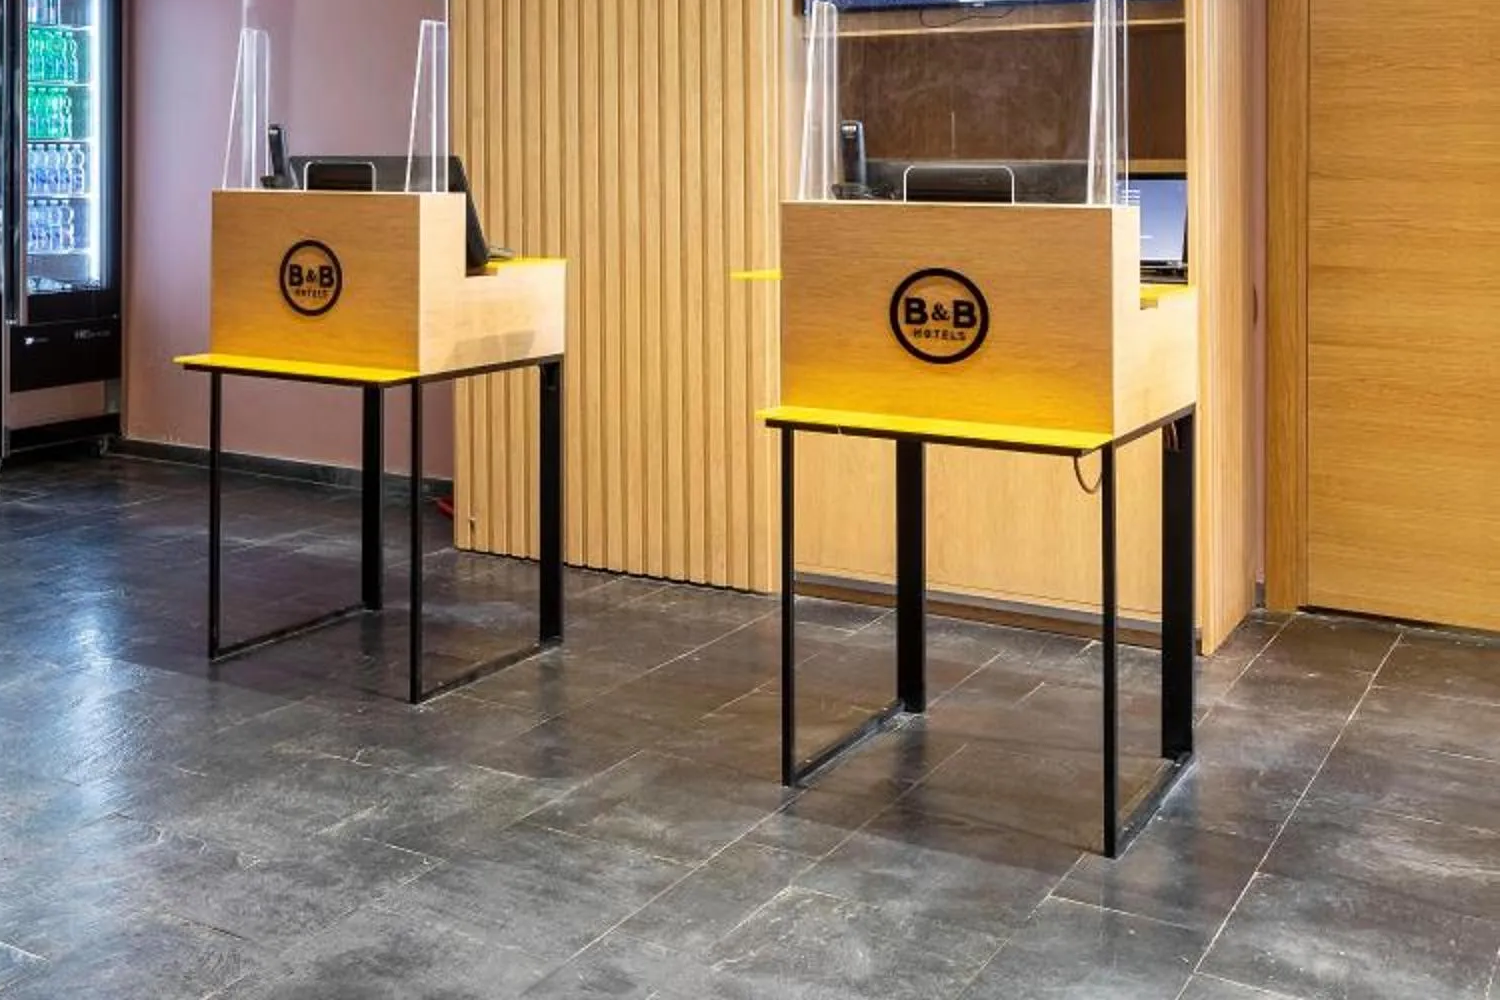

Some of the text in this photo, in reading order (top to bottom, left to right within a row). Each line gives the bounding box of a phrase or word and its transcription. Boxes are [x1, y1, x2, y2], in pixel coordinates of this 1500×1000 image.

[289, 263, 334, 288] B&B
[904, 297, 977, 329] B&B
[913, 328, 967, 341] HOTELS
